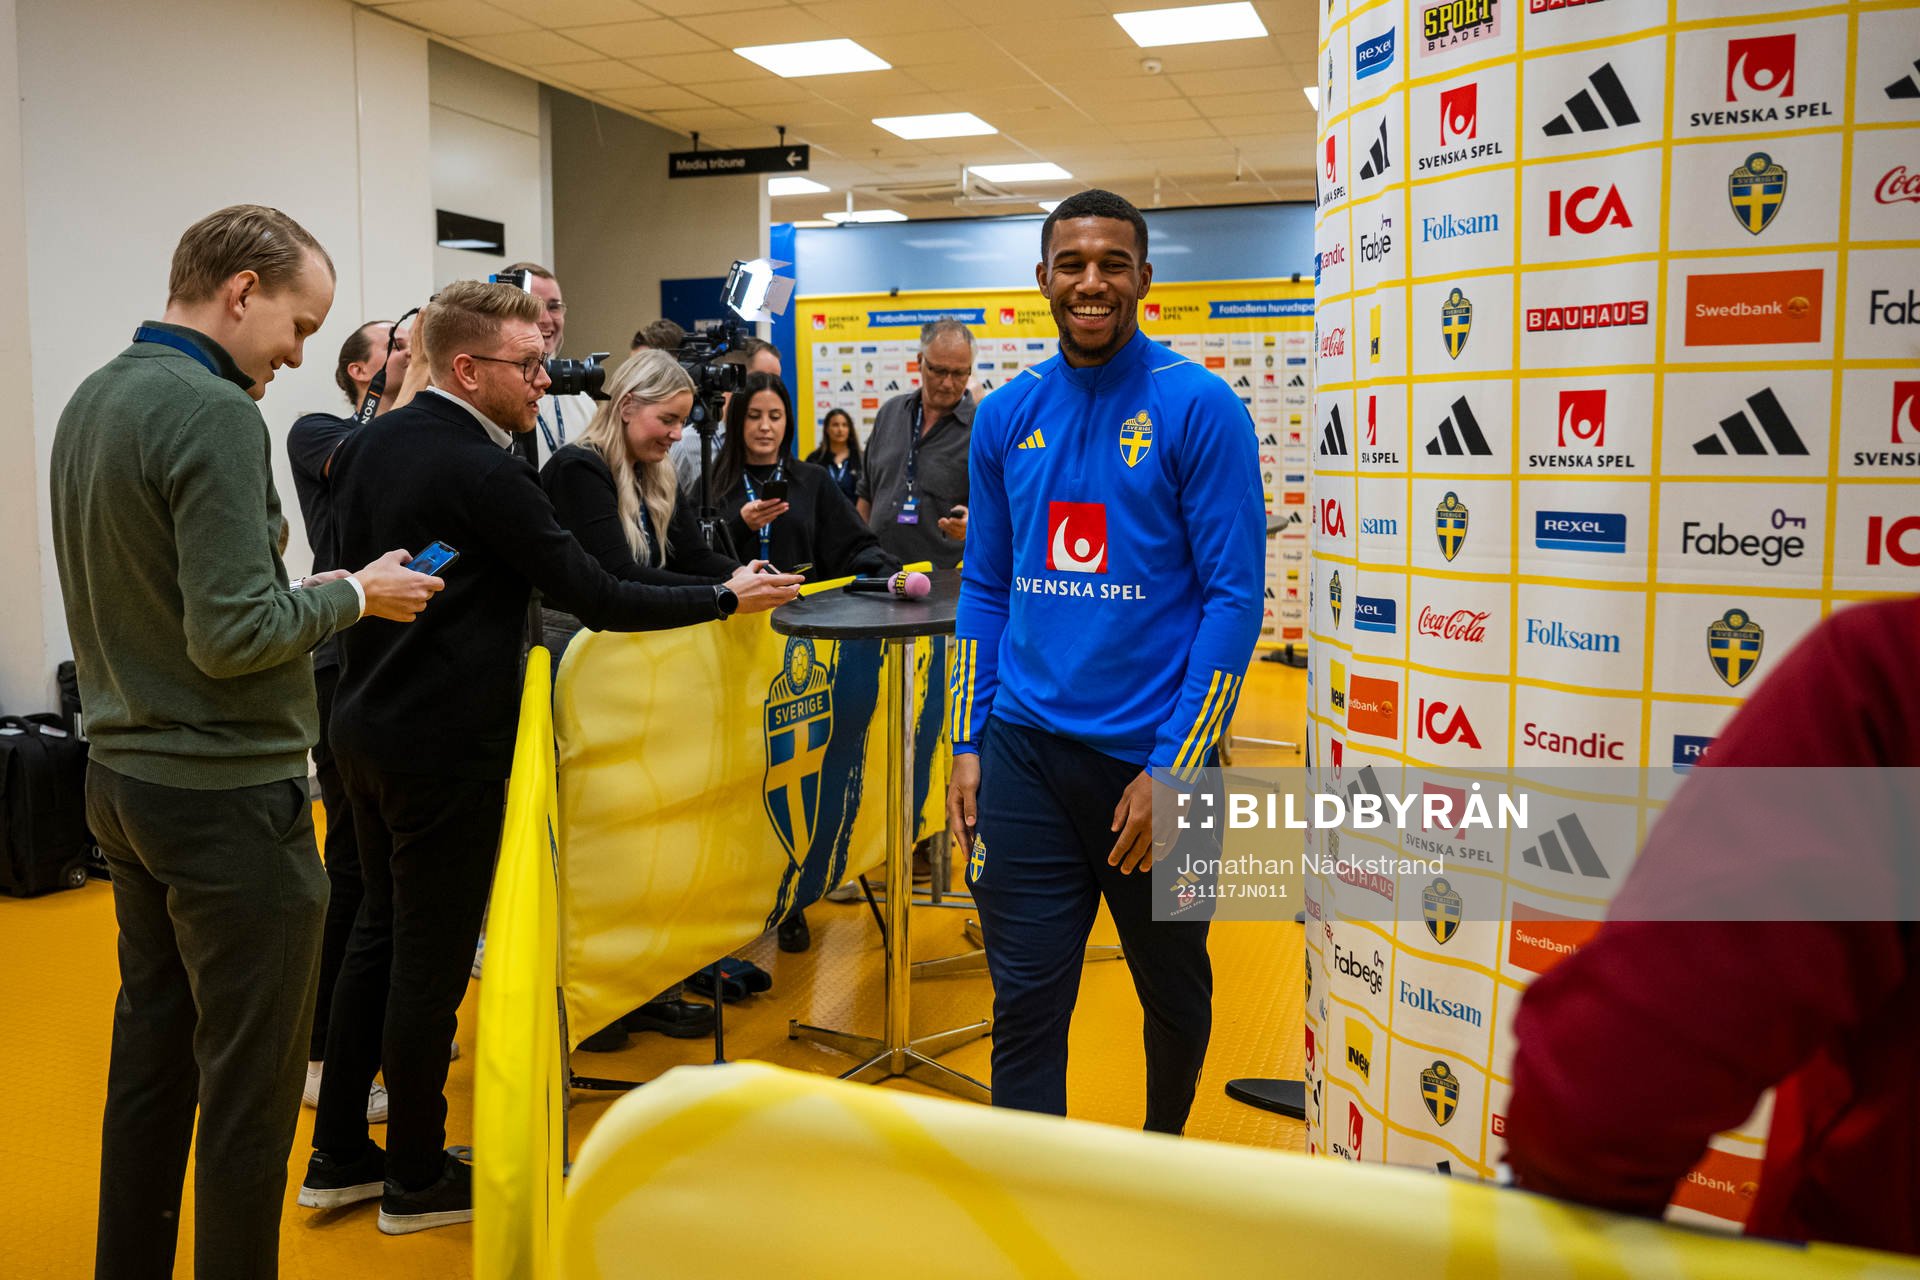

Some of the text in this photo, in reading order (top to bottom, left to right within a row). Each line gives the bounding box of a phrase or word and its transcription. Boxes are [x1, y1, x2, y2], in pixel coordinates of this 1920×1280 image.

[1424, 0, 1498, 41] SPORT
[1428, 24, 1493, 51] BLADET
[1690, 102, 1832, 126] SVENSKA SPEL
[676, 158, 745, 170] Media tribune
[1418, 142, 1502, 170] SVENSKA SPEL
[1549, 182, 1633, 236] ICA
[1422, 213, 1499, 243] Folksam
[1529, 303, 1645, 328] BAUHAUS
[1696, 301, 1782, 318] Swedbank
[361, 398, 376, 424] SON
[1372, 452, 1399, 464] SPEL
[1529, 455, 1635, 468] SVENSKA SPEL
[1854, 452, 1920, 466] SVENS
[1321, 498, 1346, 538] ICA
[1683, 522, 1805, 566] Fabege
[1016, 576, 1146, 600] SVENSKA SPEL
[1418, 605, 1491, 643] Coca-Cola
[1526, 618, 1620, 653] Folksam
[776, 695, 824, 725] SVERIGE
[1417, 698, 1482, 749] ICA
[1523, 722, 1624, 761] Scandic
[1406, 833, 1494, 863] SVENSKA SPEL
[1339, 864, 1393, 897] AUHAUS
[1335, 944, 1382, 995] Fabege
[1399, 980, 1482, 1028] Folksam
[1687, 1171, 1735, 1195] dbank
